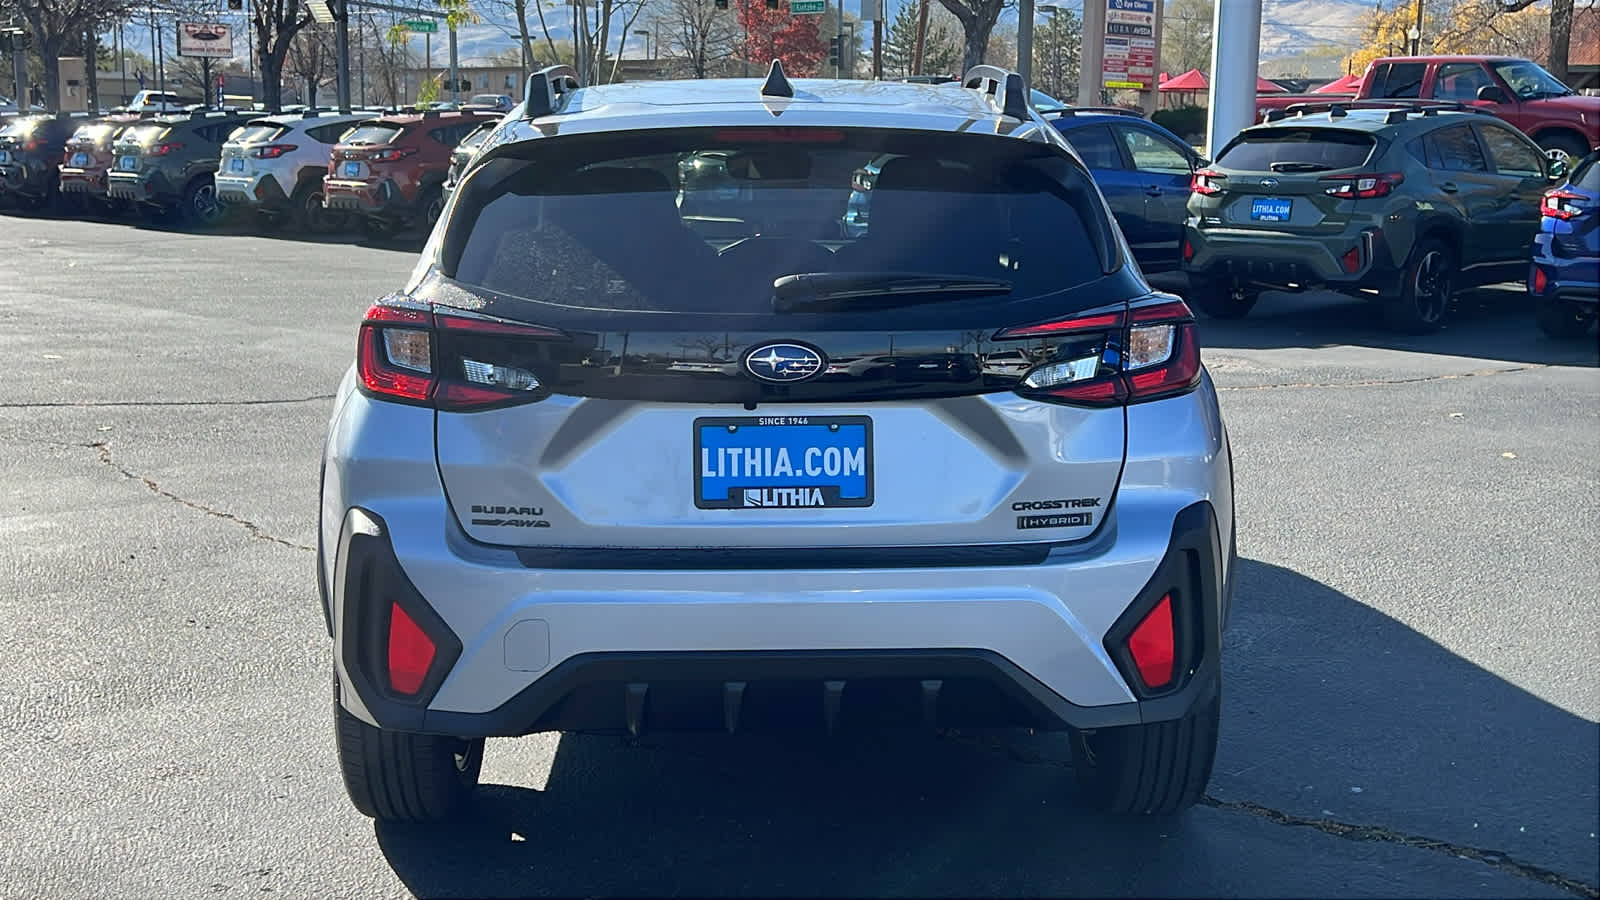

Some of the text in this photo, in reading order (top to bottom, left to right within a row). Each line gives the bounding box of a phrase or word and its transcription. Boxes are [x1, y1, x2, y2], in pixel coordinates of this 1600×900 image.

[1252, 205, 1290, 214] LITHIA.COM
[759, 417, 809, 426] SINCE 1946
[701, 447, 865, 478] LITHIA.COM
[762, 487, 825, 507] LITHIA
[1012, 498, 1101, 511] CROSSTREK
[471, 505, 544, 516] SUBARU
[501, 519, 551, 528] AWD
[1030, 516, 1081, 526] HYBRID
